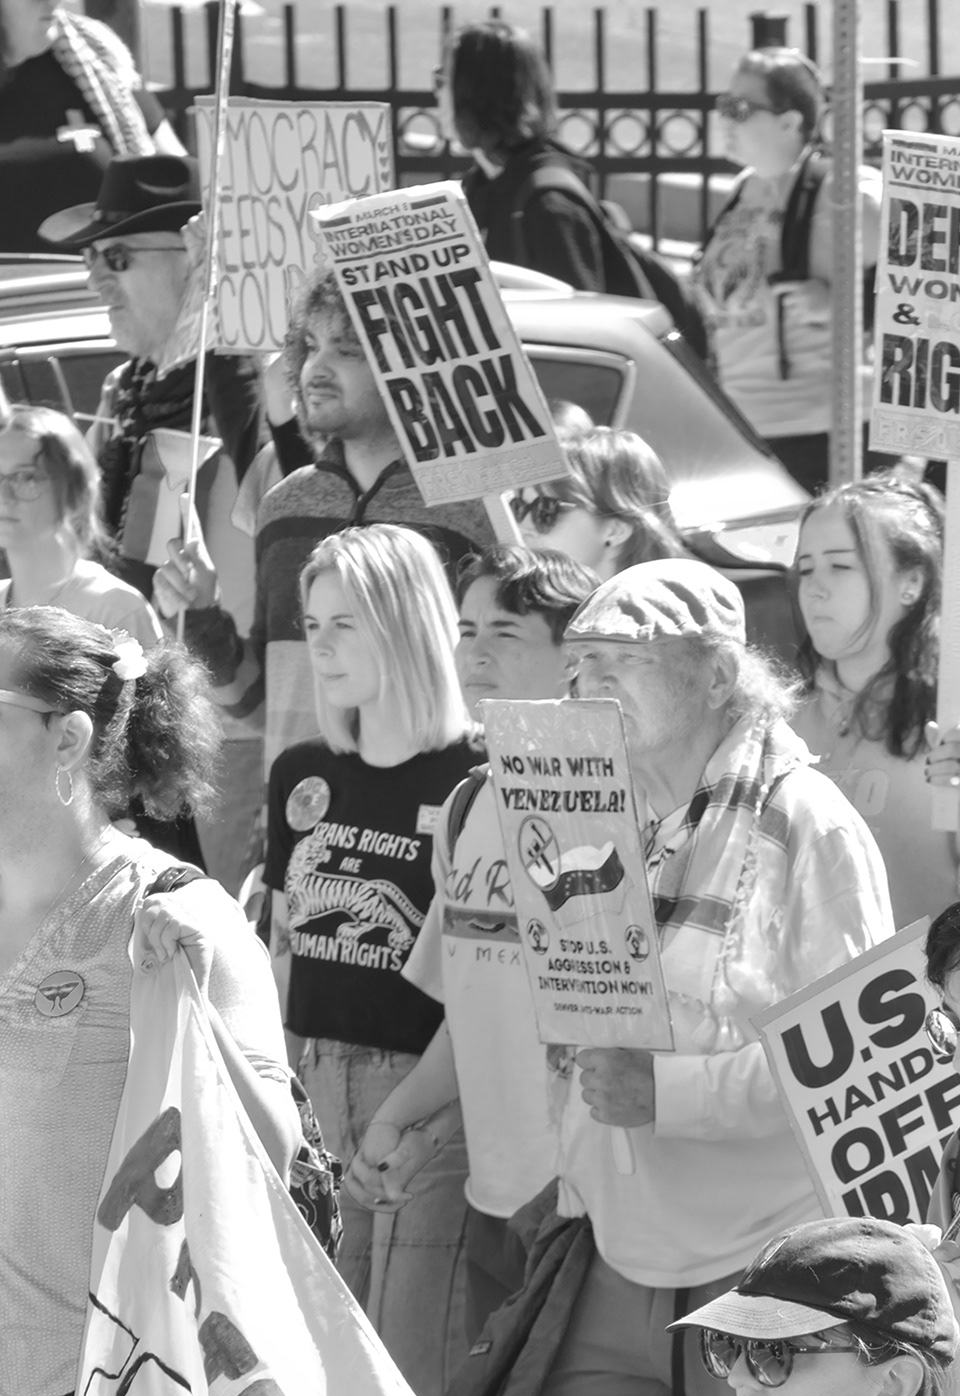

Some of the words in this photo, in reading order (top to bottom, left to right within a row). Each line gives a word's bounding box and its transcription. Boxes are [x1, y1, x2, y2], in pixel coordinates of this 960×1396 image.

[196, 109, 386, 194] DMOCRACY
[208, 195, 287, 272] EEDS
[323, 207, 454, 243] INTERNATIONAL
[329, 229, 413, 257] WOMEN'S
[416, 219, 458, 241] DAY
[341, 254, 430, 286] STAND
[433, 243, 471, 267] UP
[351, 267, 502, 374] FIGHT
[893, 303, 921, 326] &
[385, 354, 547, 463] BACK
[500, 755, 525, 775] NO
[526, 756, 562, 776] WAR
[566, 757, 614, 777] WITH
[501, 788, 626, 813] VENEZUELA!
[357, 829, 421, 861] RIGHTS
[339, 856, 363, 873] ARE
[340, 940, 402, 971] RIGHTS
[560, 939, 583, 955] STOP
[548, 959, 621, 975] AGGRESSION
[538, 976, 620, 996] INTERVENTION
[621, 981, 654, 996] NOW!
[841, 1131, 955, 1226] IRA
